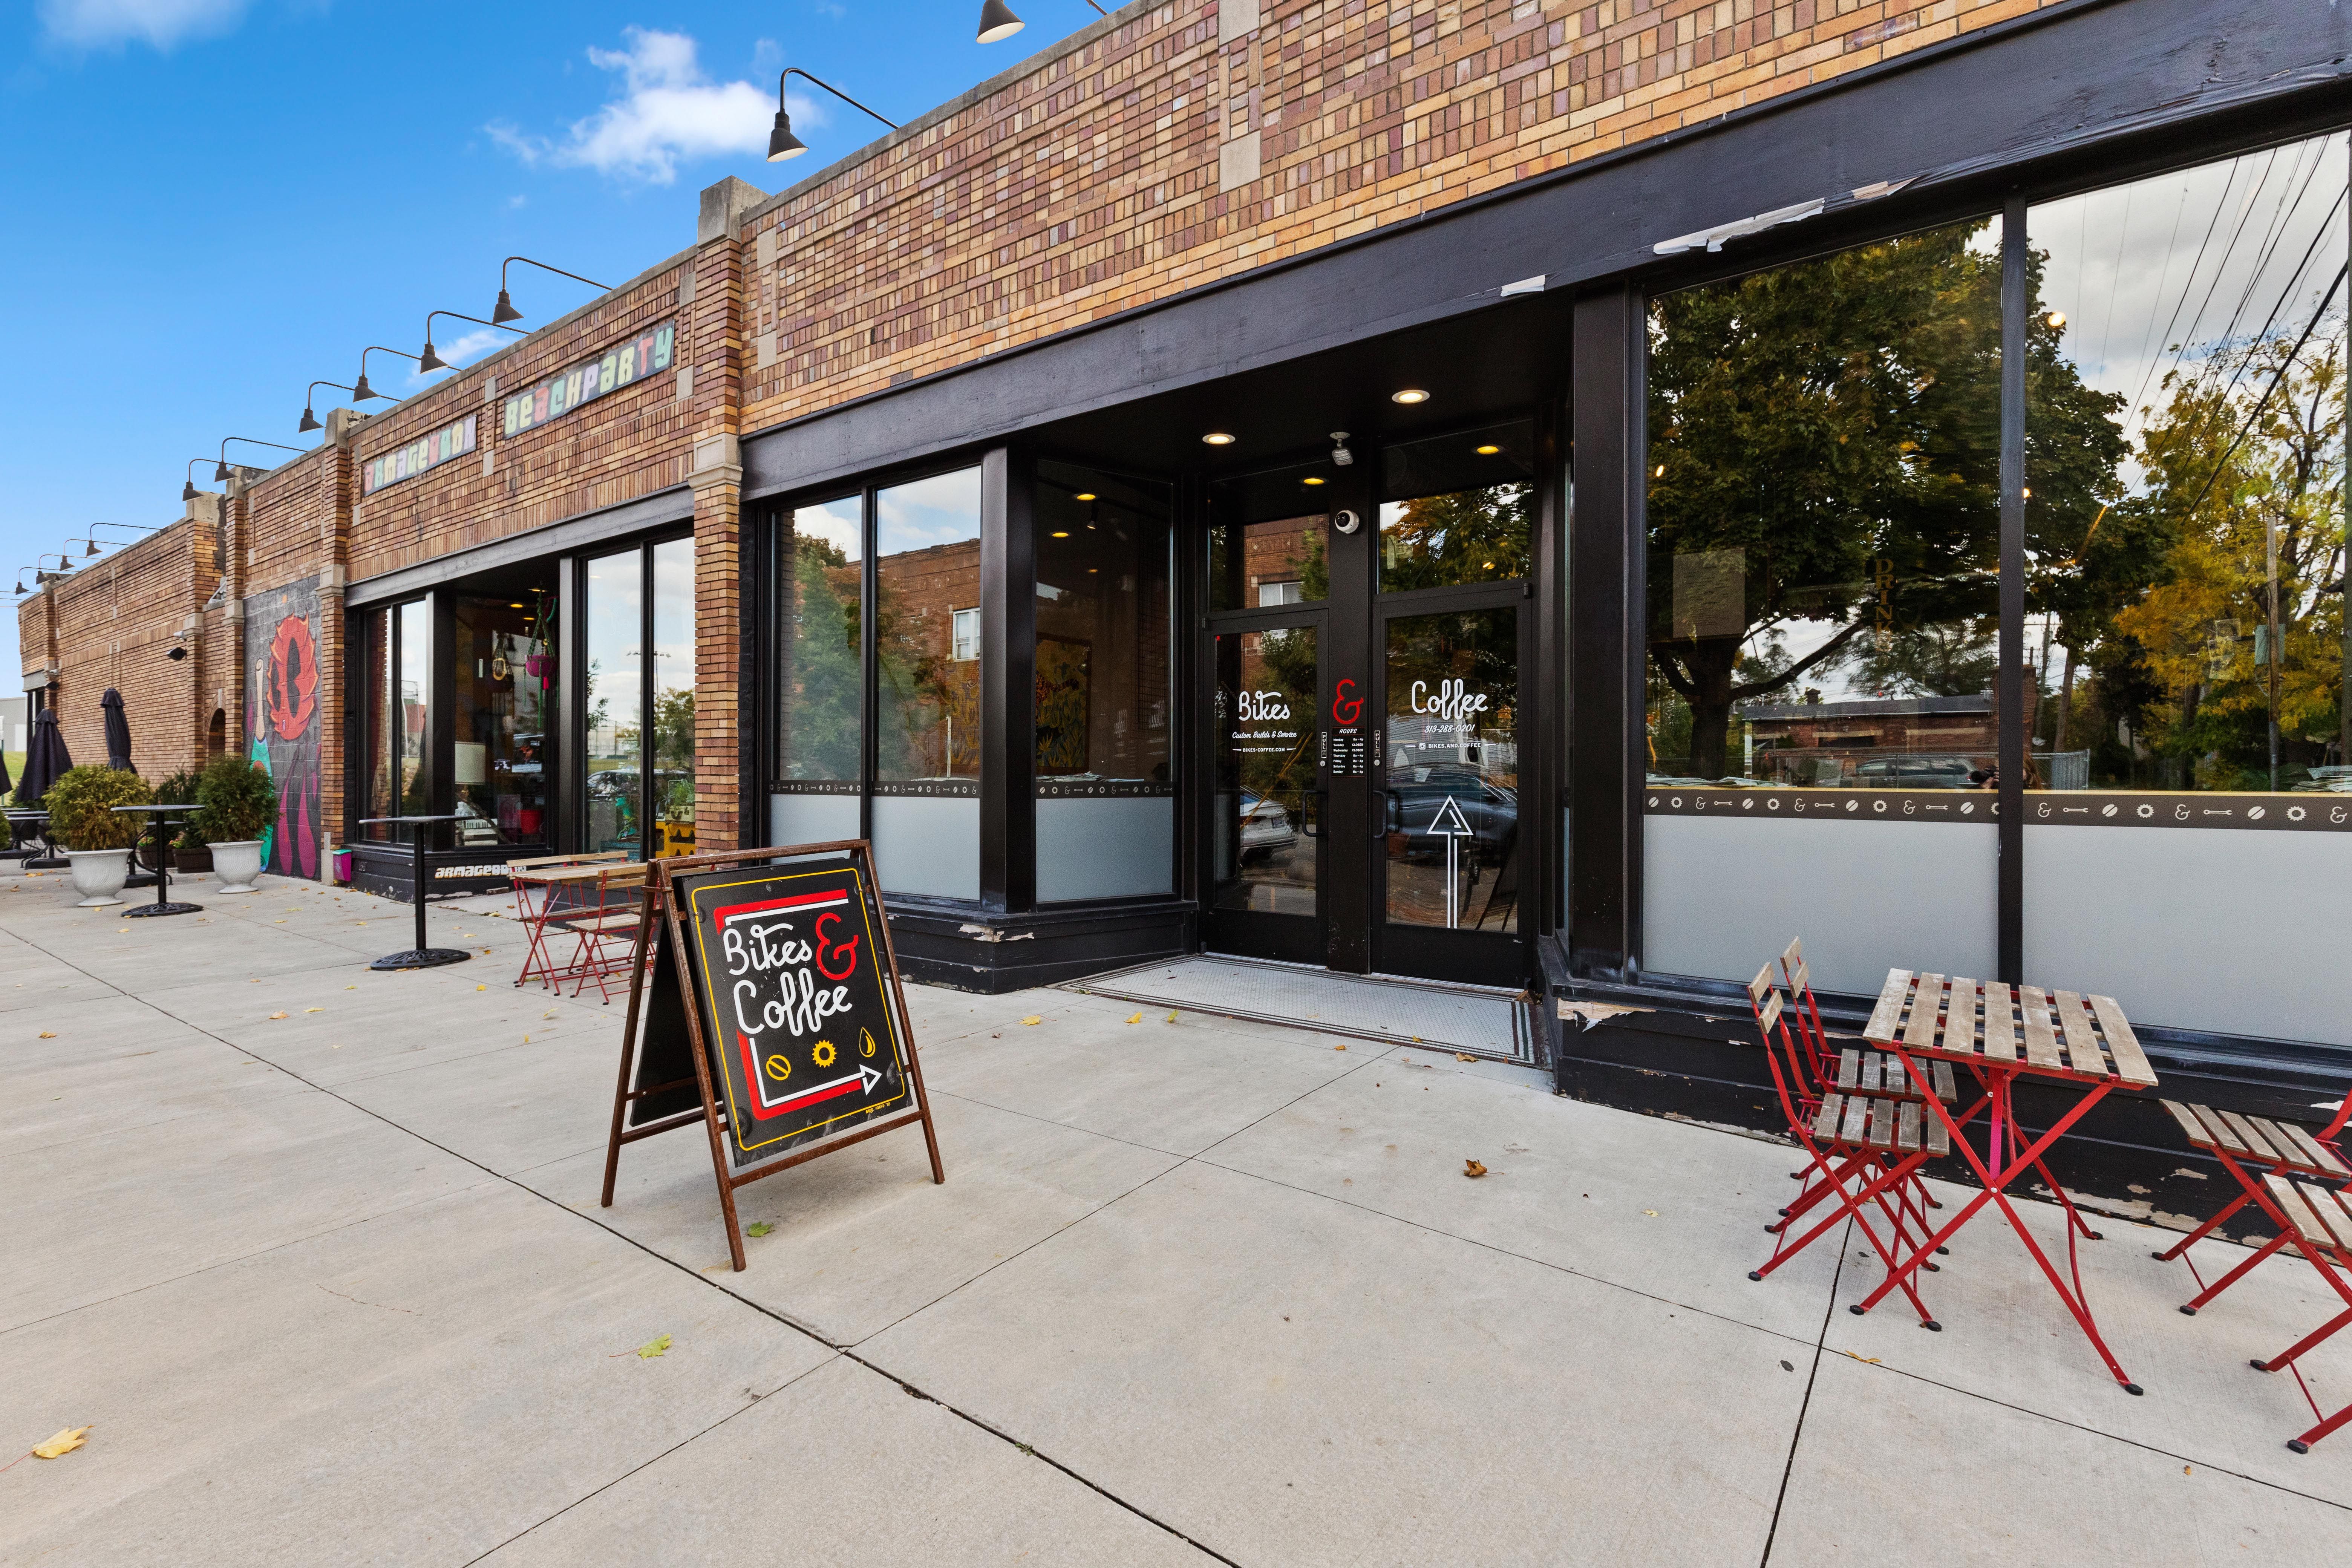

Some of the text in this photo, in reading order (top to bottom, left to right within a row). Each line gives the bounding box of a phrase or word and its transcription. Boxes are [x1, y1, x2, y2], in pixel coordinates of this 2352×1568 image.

[1239, 690, 1290, 721] Bikes
[1333, 678, 1364, 724] &
[1412, 678, 1488, 720] Coffee
[1424, 724, 1475, 733] 313-288-0201
[723, 913, 859, 980] Bikes &
[733, 968, 853, 1037] Coffee
